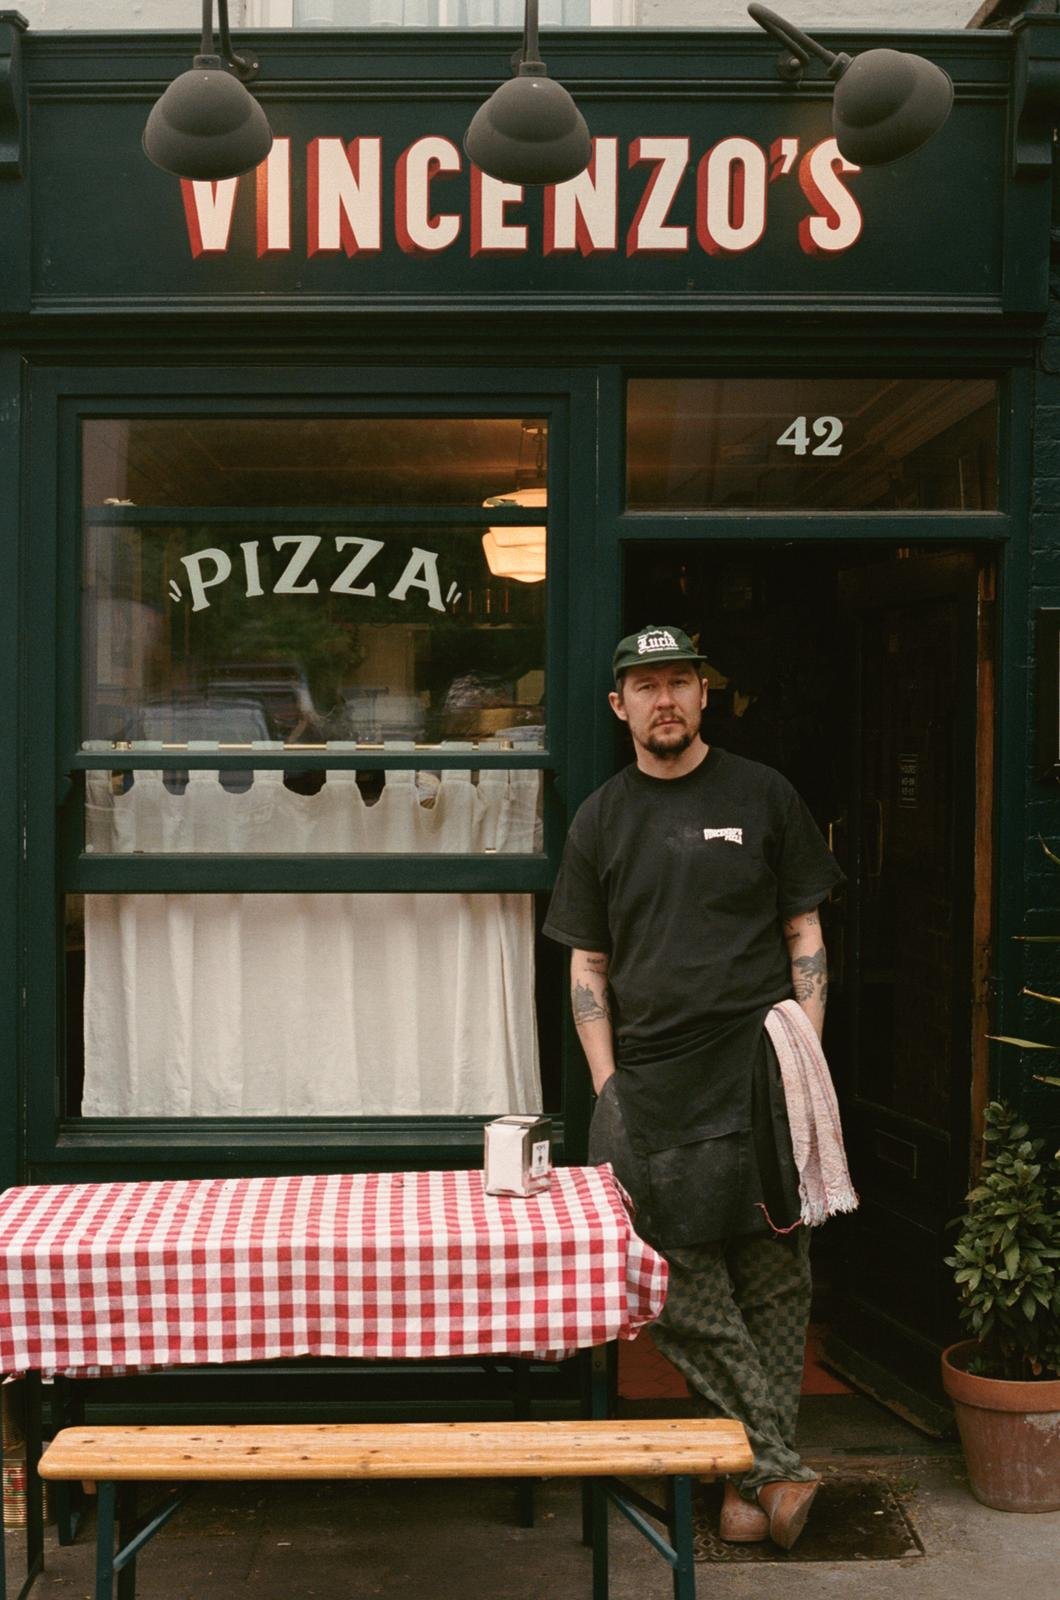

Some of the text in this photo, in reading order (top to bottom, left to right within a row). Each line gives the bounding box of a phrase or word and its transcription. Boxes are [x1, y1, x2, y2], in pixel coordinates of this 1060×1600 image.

[180, 135, 863, 257] VINCENZO'S
[776, 415, 843, 456] 42
[180, 535, 446, 612] PIZZA
